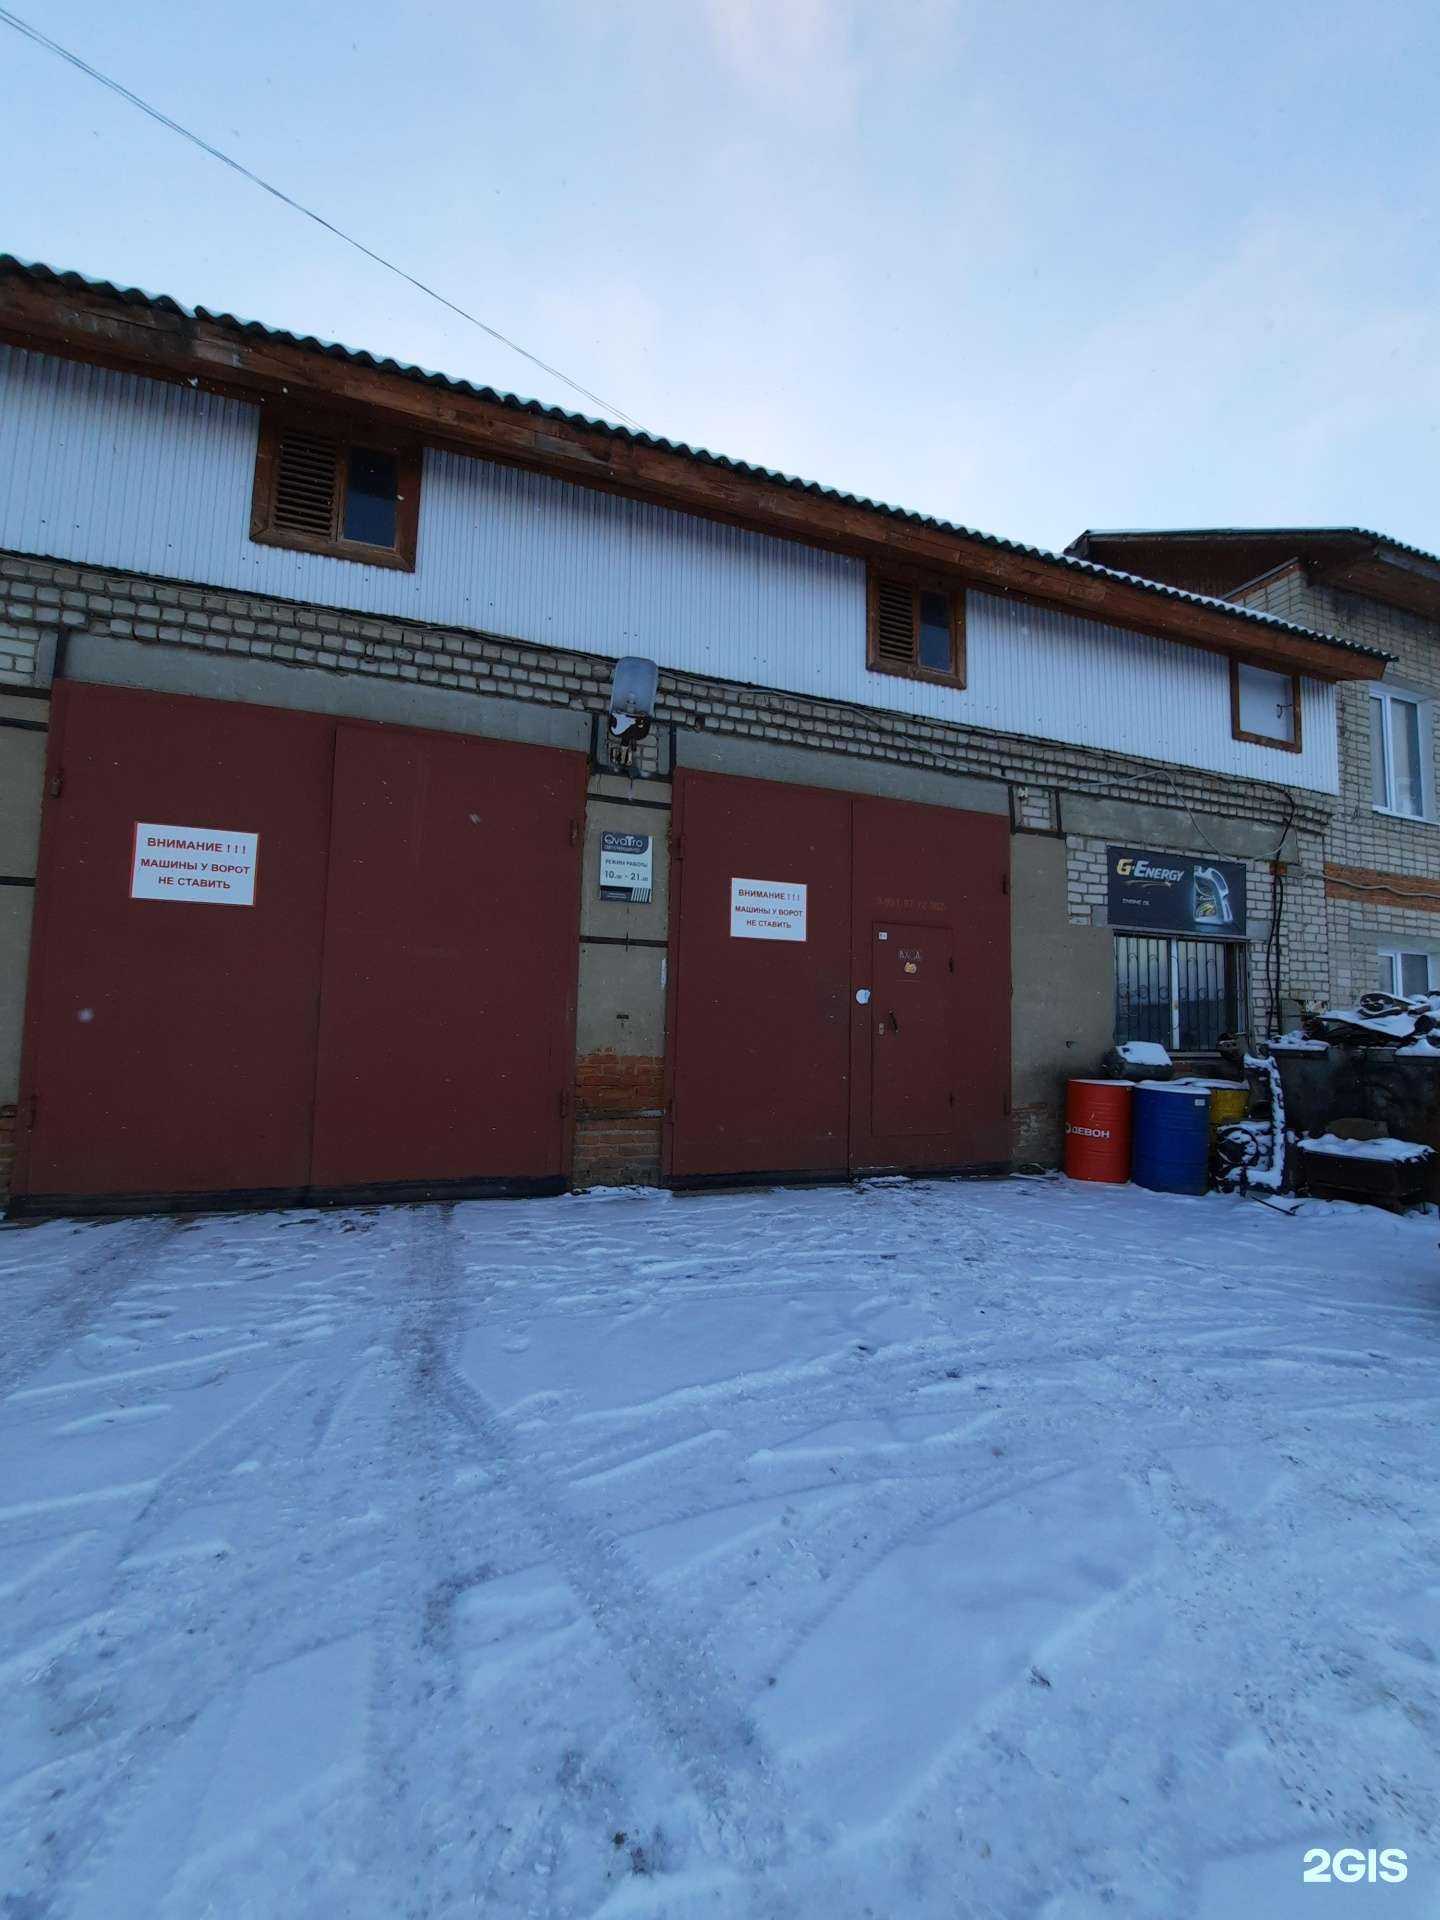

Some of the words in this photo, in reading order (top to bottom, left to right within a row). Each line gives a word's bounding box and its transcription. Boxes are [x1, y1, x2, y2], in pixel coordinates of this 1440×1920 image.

[147, 837, 223, 853] ВНИМАНИЕ
[140, 858, 198, 871] МАШИНЫ
[201, 863, 209, 871] У
[211, 863, 251, 875] ВОРОТ
[158, 876, 175, 886] НЕ
[177, 877, 232, 890] СТАВИТЬ
[738, 888, 786, 900] ВНИМАНИЕ
[735, 904, 771, 915] МАШИНЫ
[778, 908, 803, 918] ВОРОТ
[746, 919, 757, 927] НЕ
[758, 920, 792, 929] СТАВИТЬ
[1071, 1126, 1110, 1139] ДЕВОН
